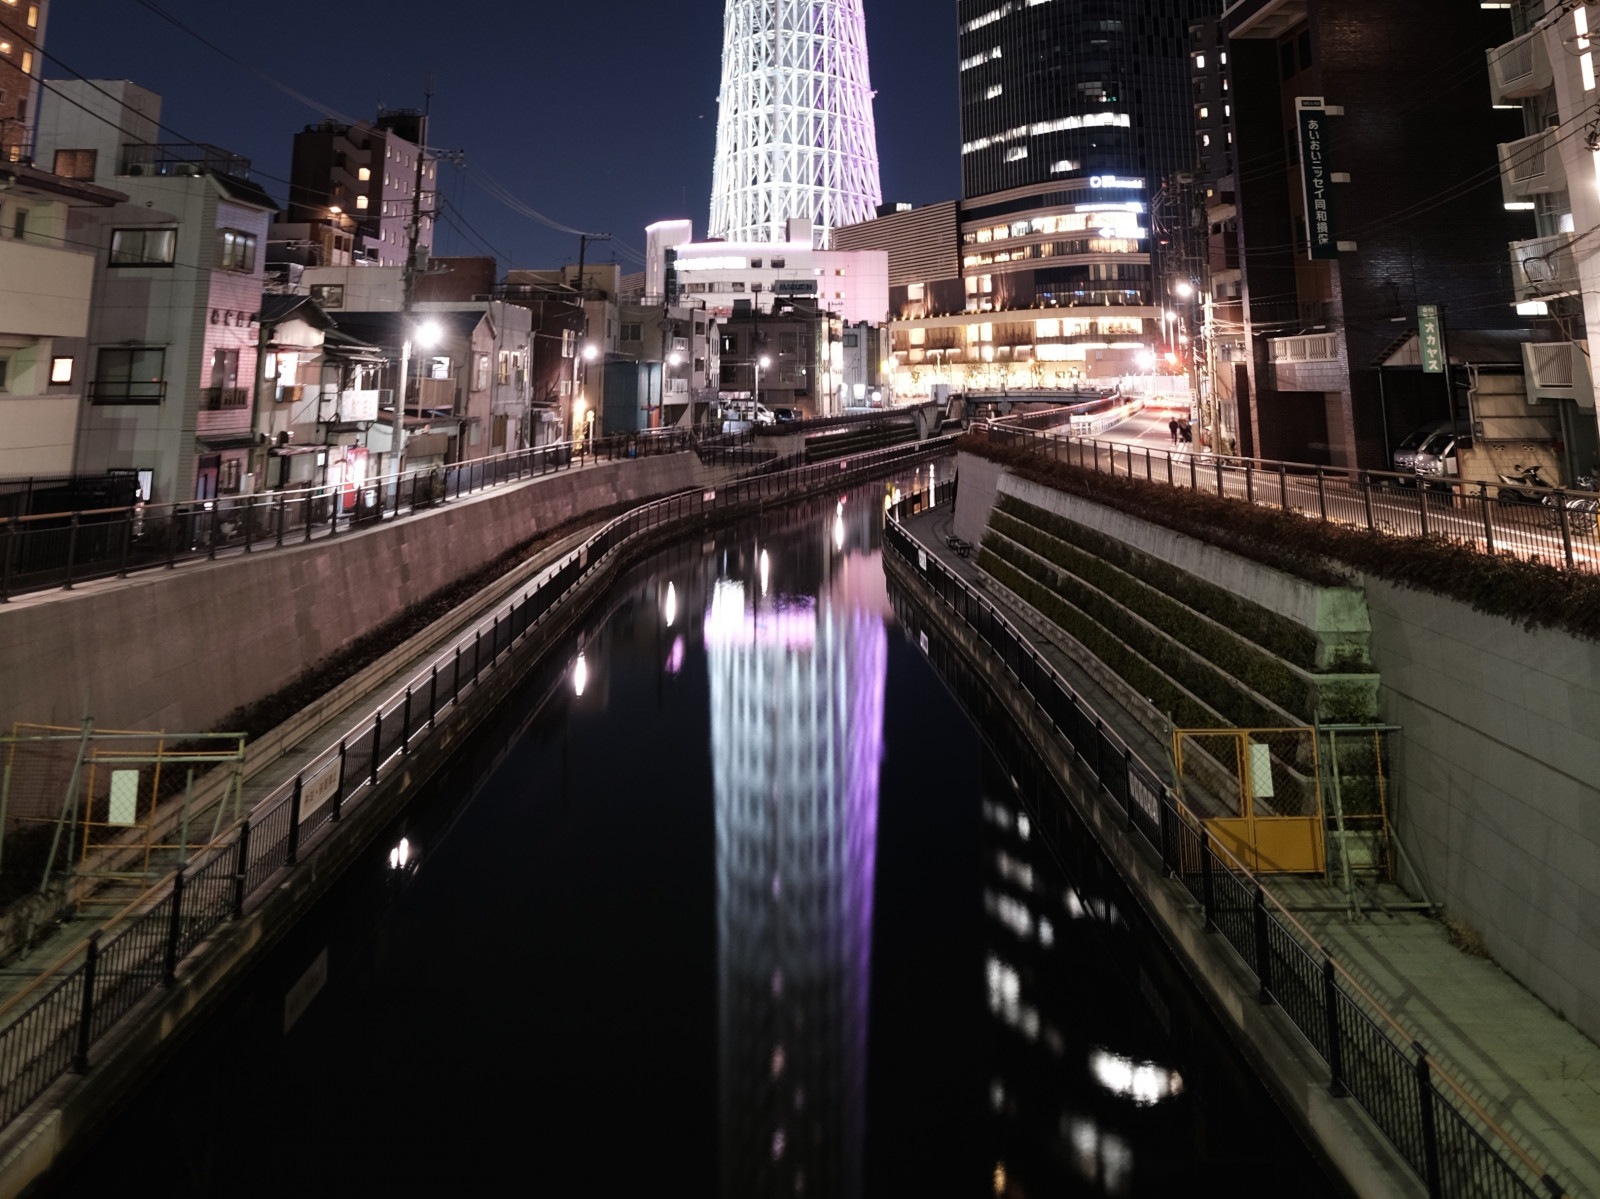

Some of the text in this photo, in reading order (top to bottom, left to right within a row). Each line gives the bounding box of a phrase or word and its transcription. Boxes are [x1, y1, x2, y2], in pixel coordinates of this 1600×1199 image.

[1308, 119, 1329, 244] あいおいニッセイ同和損保
[1424, 322, 1439, 370] オカヤス
